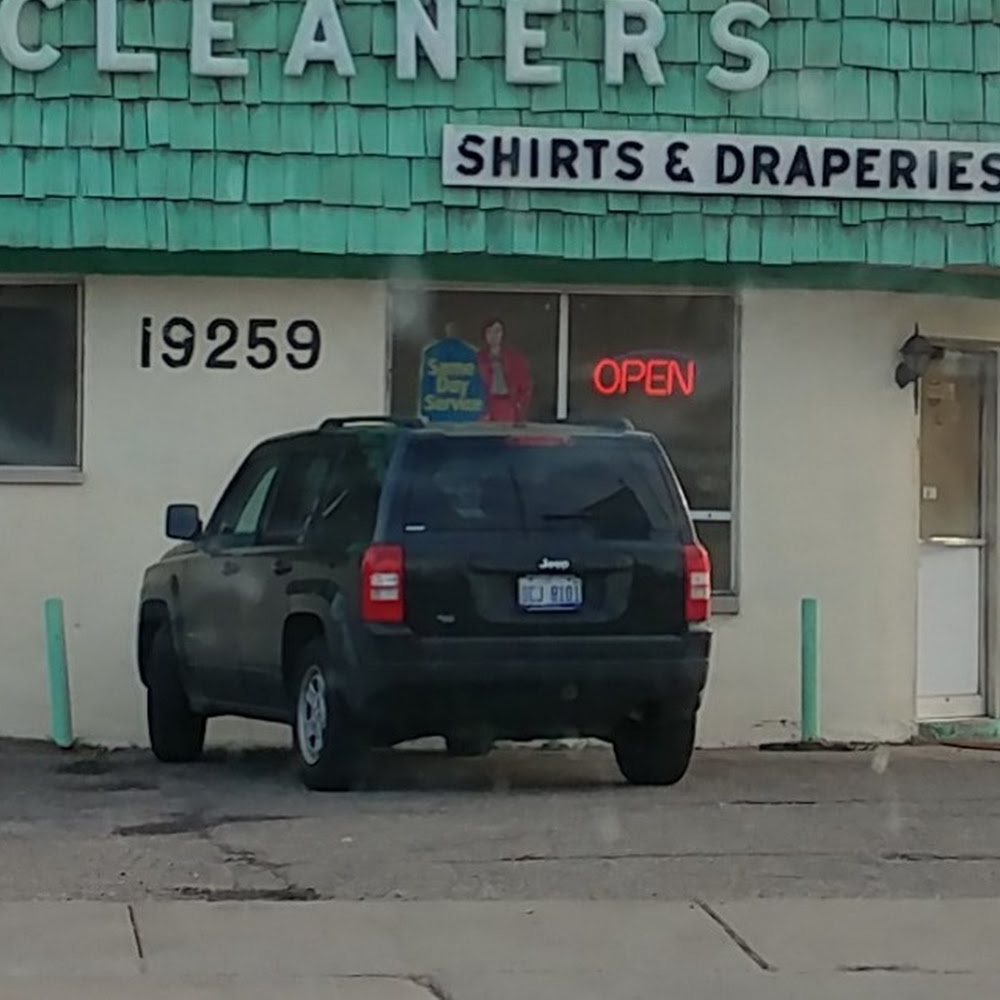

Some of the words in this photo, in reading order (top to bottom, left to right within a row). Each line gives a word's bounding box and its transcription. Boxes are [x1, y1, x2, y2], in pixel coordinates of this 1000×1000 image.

[456, 133, 645, 182] SHIRTS
[664, 141, 694, 183] &
[715, 143, 1000, 192] DRAPERIES
[140, 316, 321, 370] 19259
[592, 357, 696, 396] OPEN
[538, 557, 570, 570] Jeep
